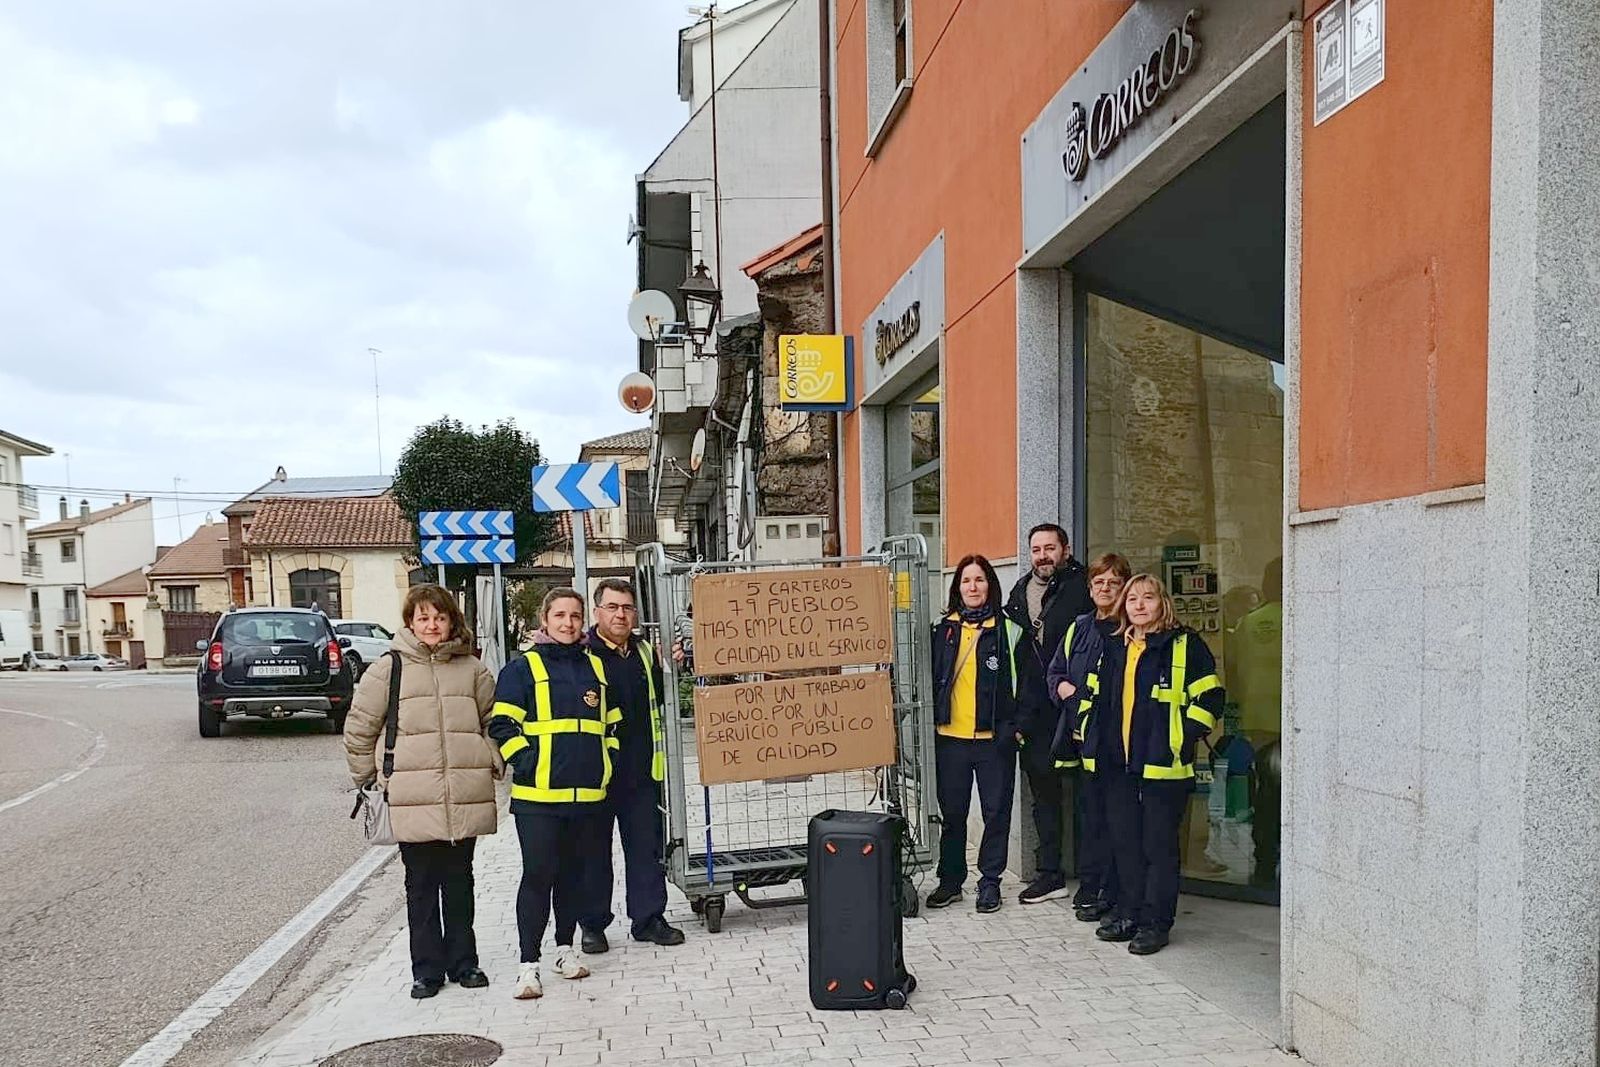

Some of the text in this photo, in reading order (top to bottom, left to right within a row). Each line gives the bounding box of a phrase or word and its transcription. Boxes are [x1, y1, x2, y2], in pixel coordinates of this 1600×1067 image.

[1087, 9, 1195, 161] CORREOS
[883, 301, 921, 360] CORREOS
[785, 338, 798, 399] CORREOS
[747, 578, 852, 596] 5 CARTEROS
[768, 596, 858, 614] PUEBLOS
[715, 645, 780, 665] CALIDAD
[735, 678, 866, 705] POR UN TRABAJO
[772, 704, 803, 720] POR
[815, 701, 837, 718] UN
[721, 750, 741, 766] DE
